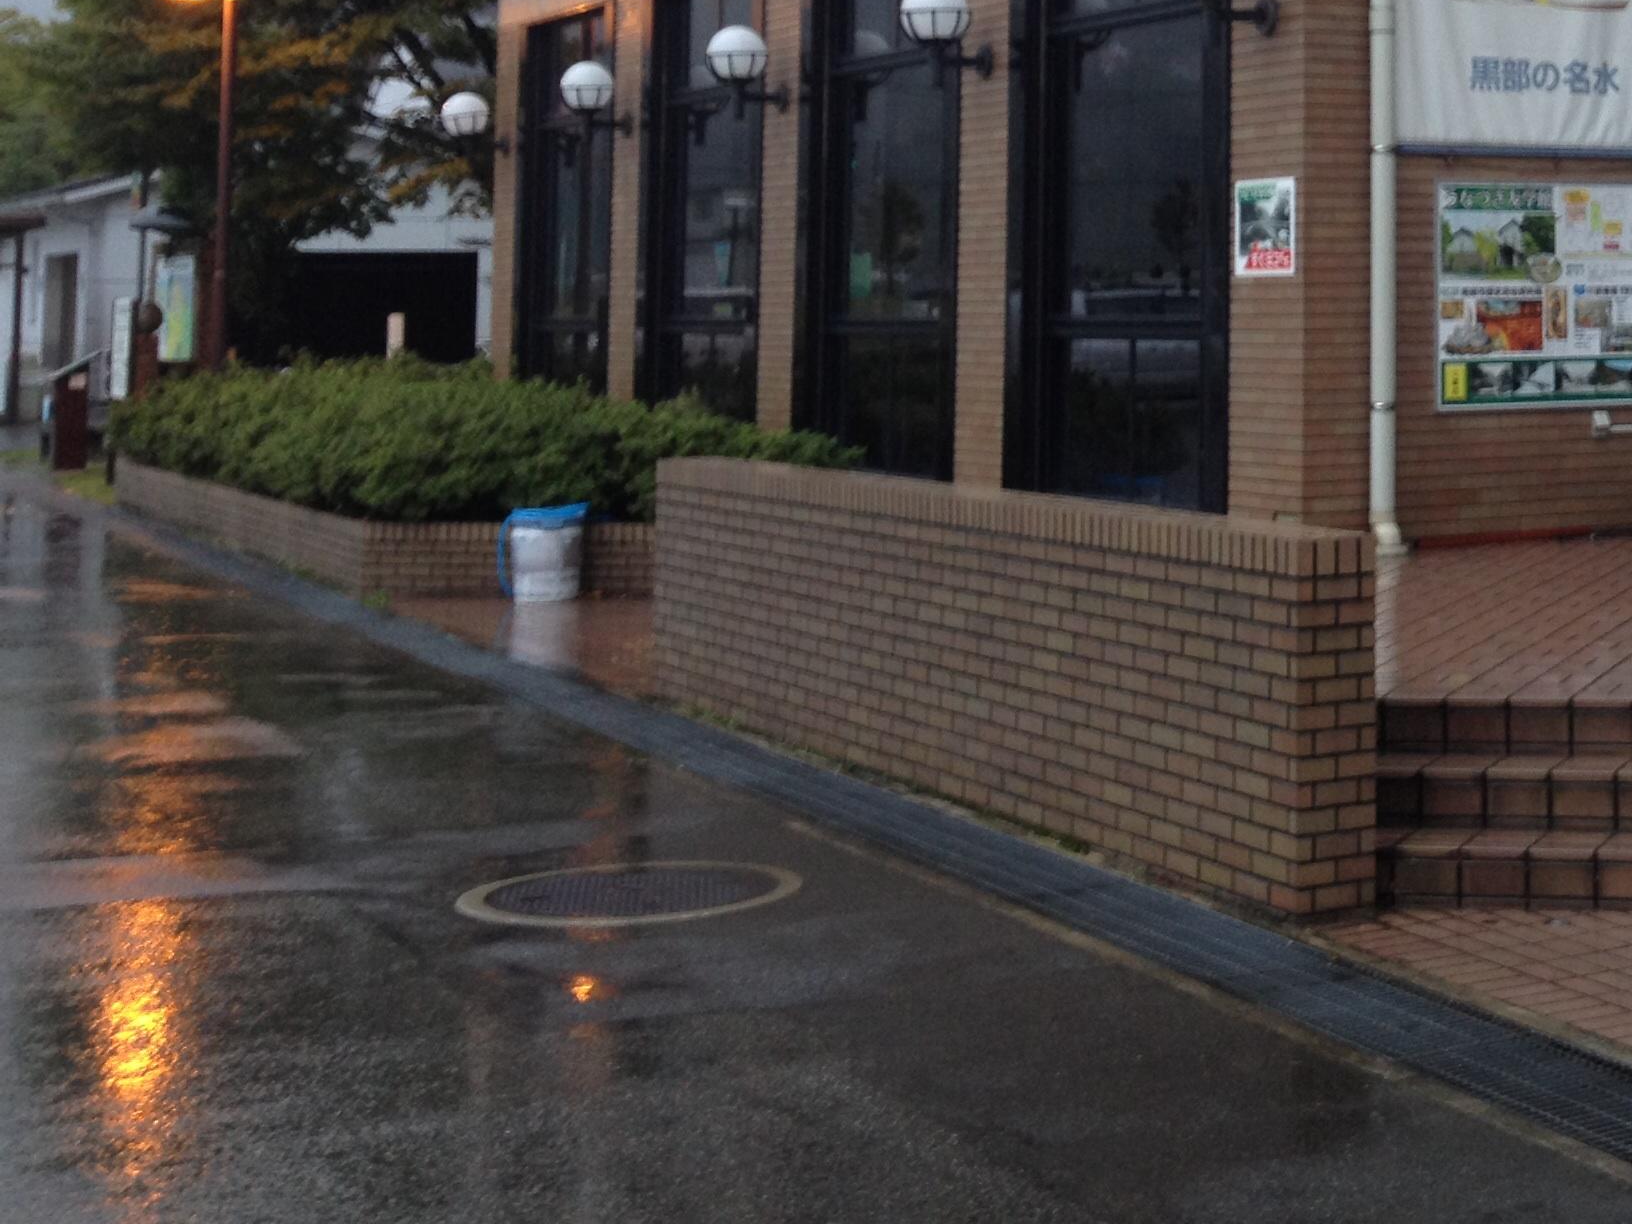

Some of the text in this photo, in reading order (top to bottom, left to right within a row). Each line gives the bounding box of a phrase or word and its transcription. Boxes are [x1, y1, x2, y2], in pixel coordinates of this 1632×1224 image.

[1469, 55, 1621, 96] 黒部の名水
